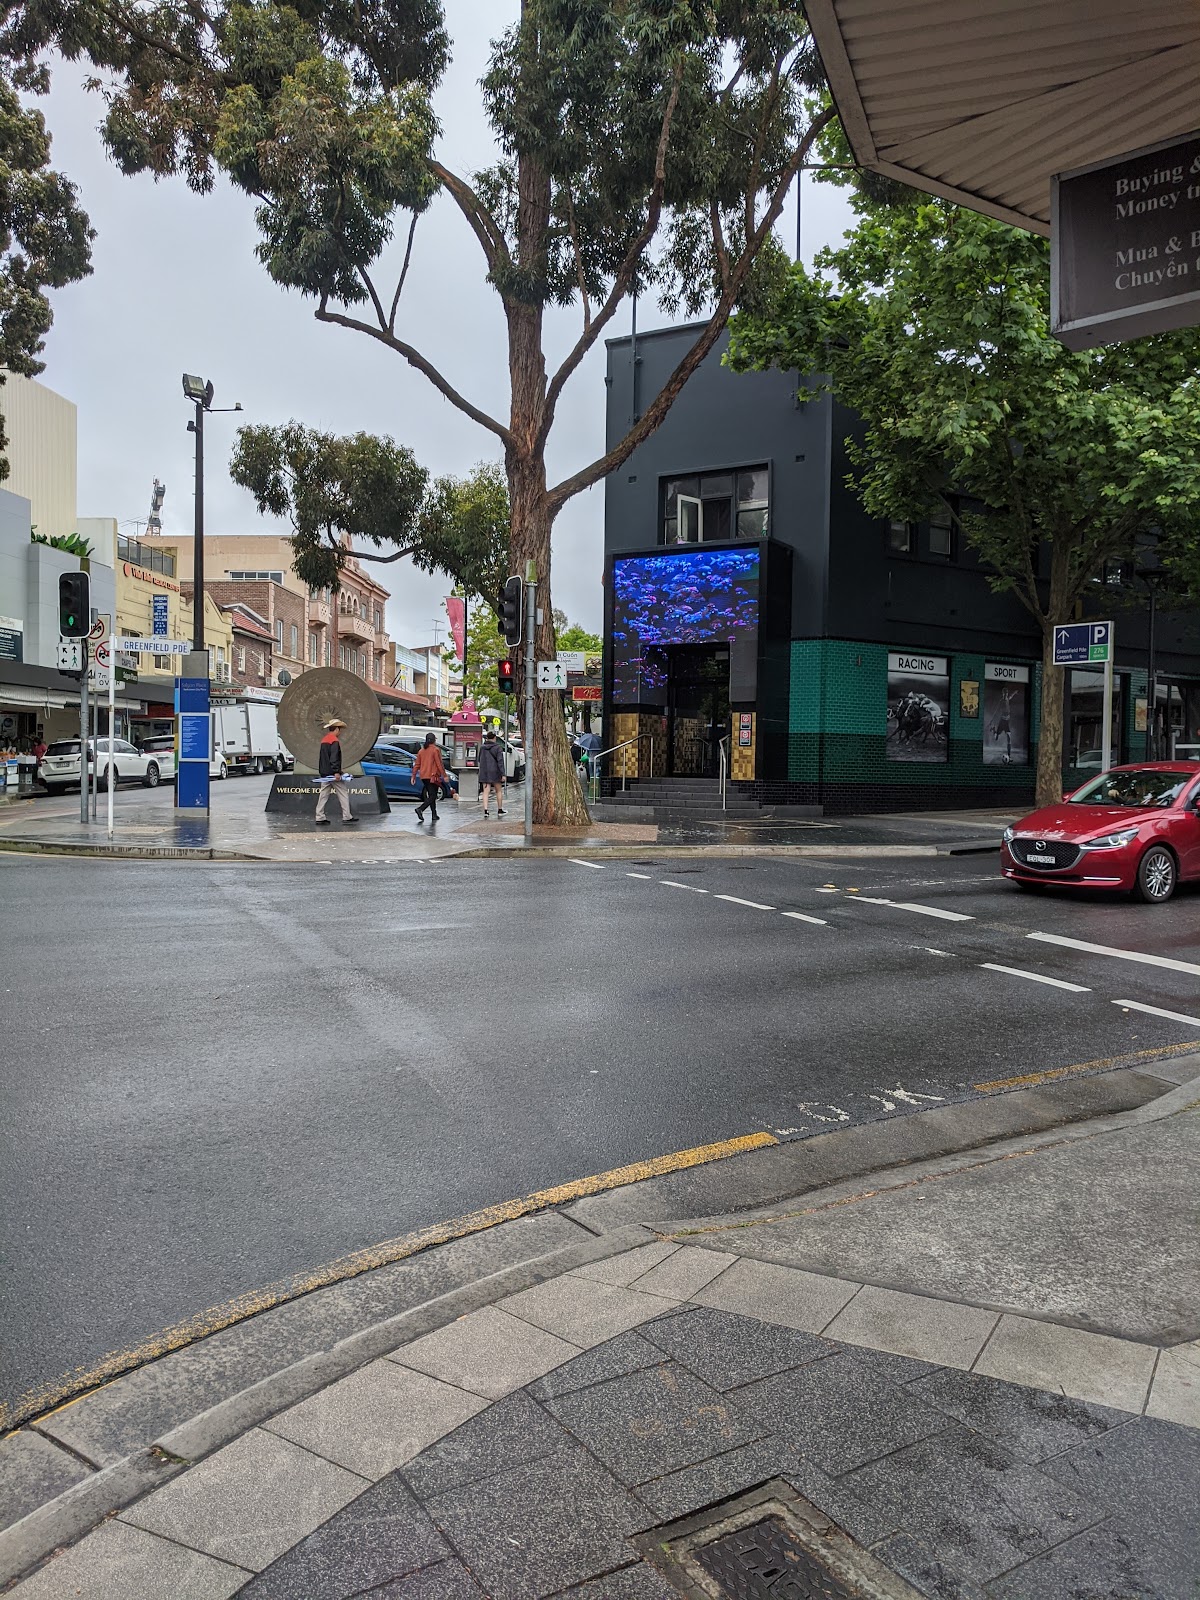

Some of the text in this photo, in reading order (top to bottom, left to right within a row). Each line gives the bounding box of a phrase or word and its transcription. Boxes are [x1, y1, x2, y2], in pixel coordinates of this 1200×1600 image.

[1116, 166, 1183, 197] Buying
[1115, 191, 1180, 220] Money
[1115, 246, 1158, 267] Mua
[1165, 236, 1182, 255] &
[1115, 256, 1188, 290] Chuyển
[1094, 626, 1106, 643] P
[124, 641, 169, 652] GREENFIELD
[898, 657, 935, 671] RACING
[994, 667, 1017, 678] SPORT
